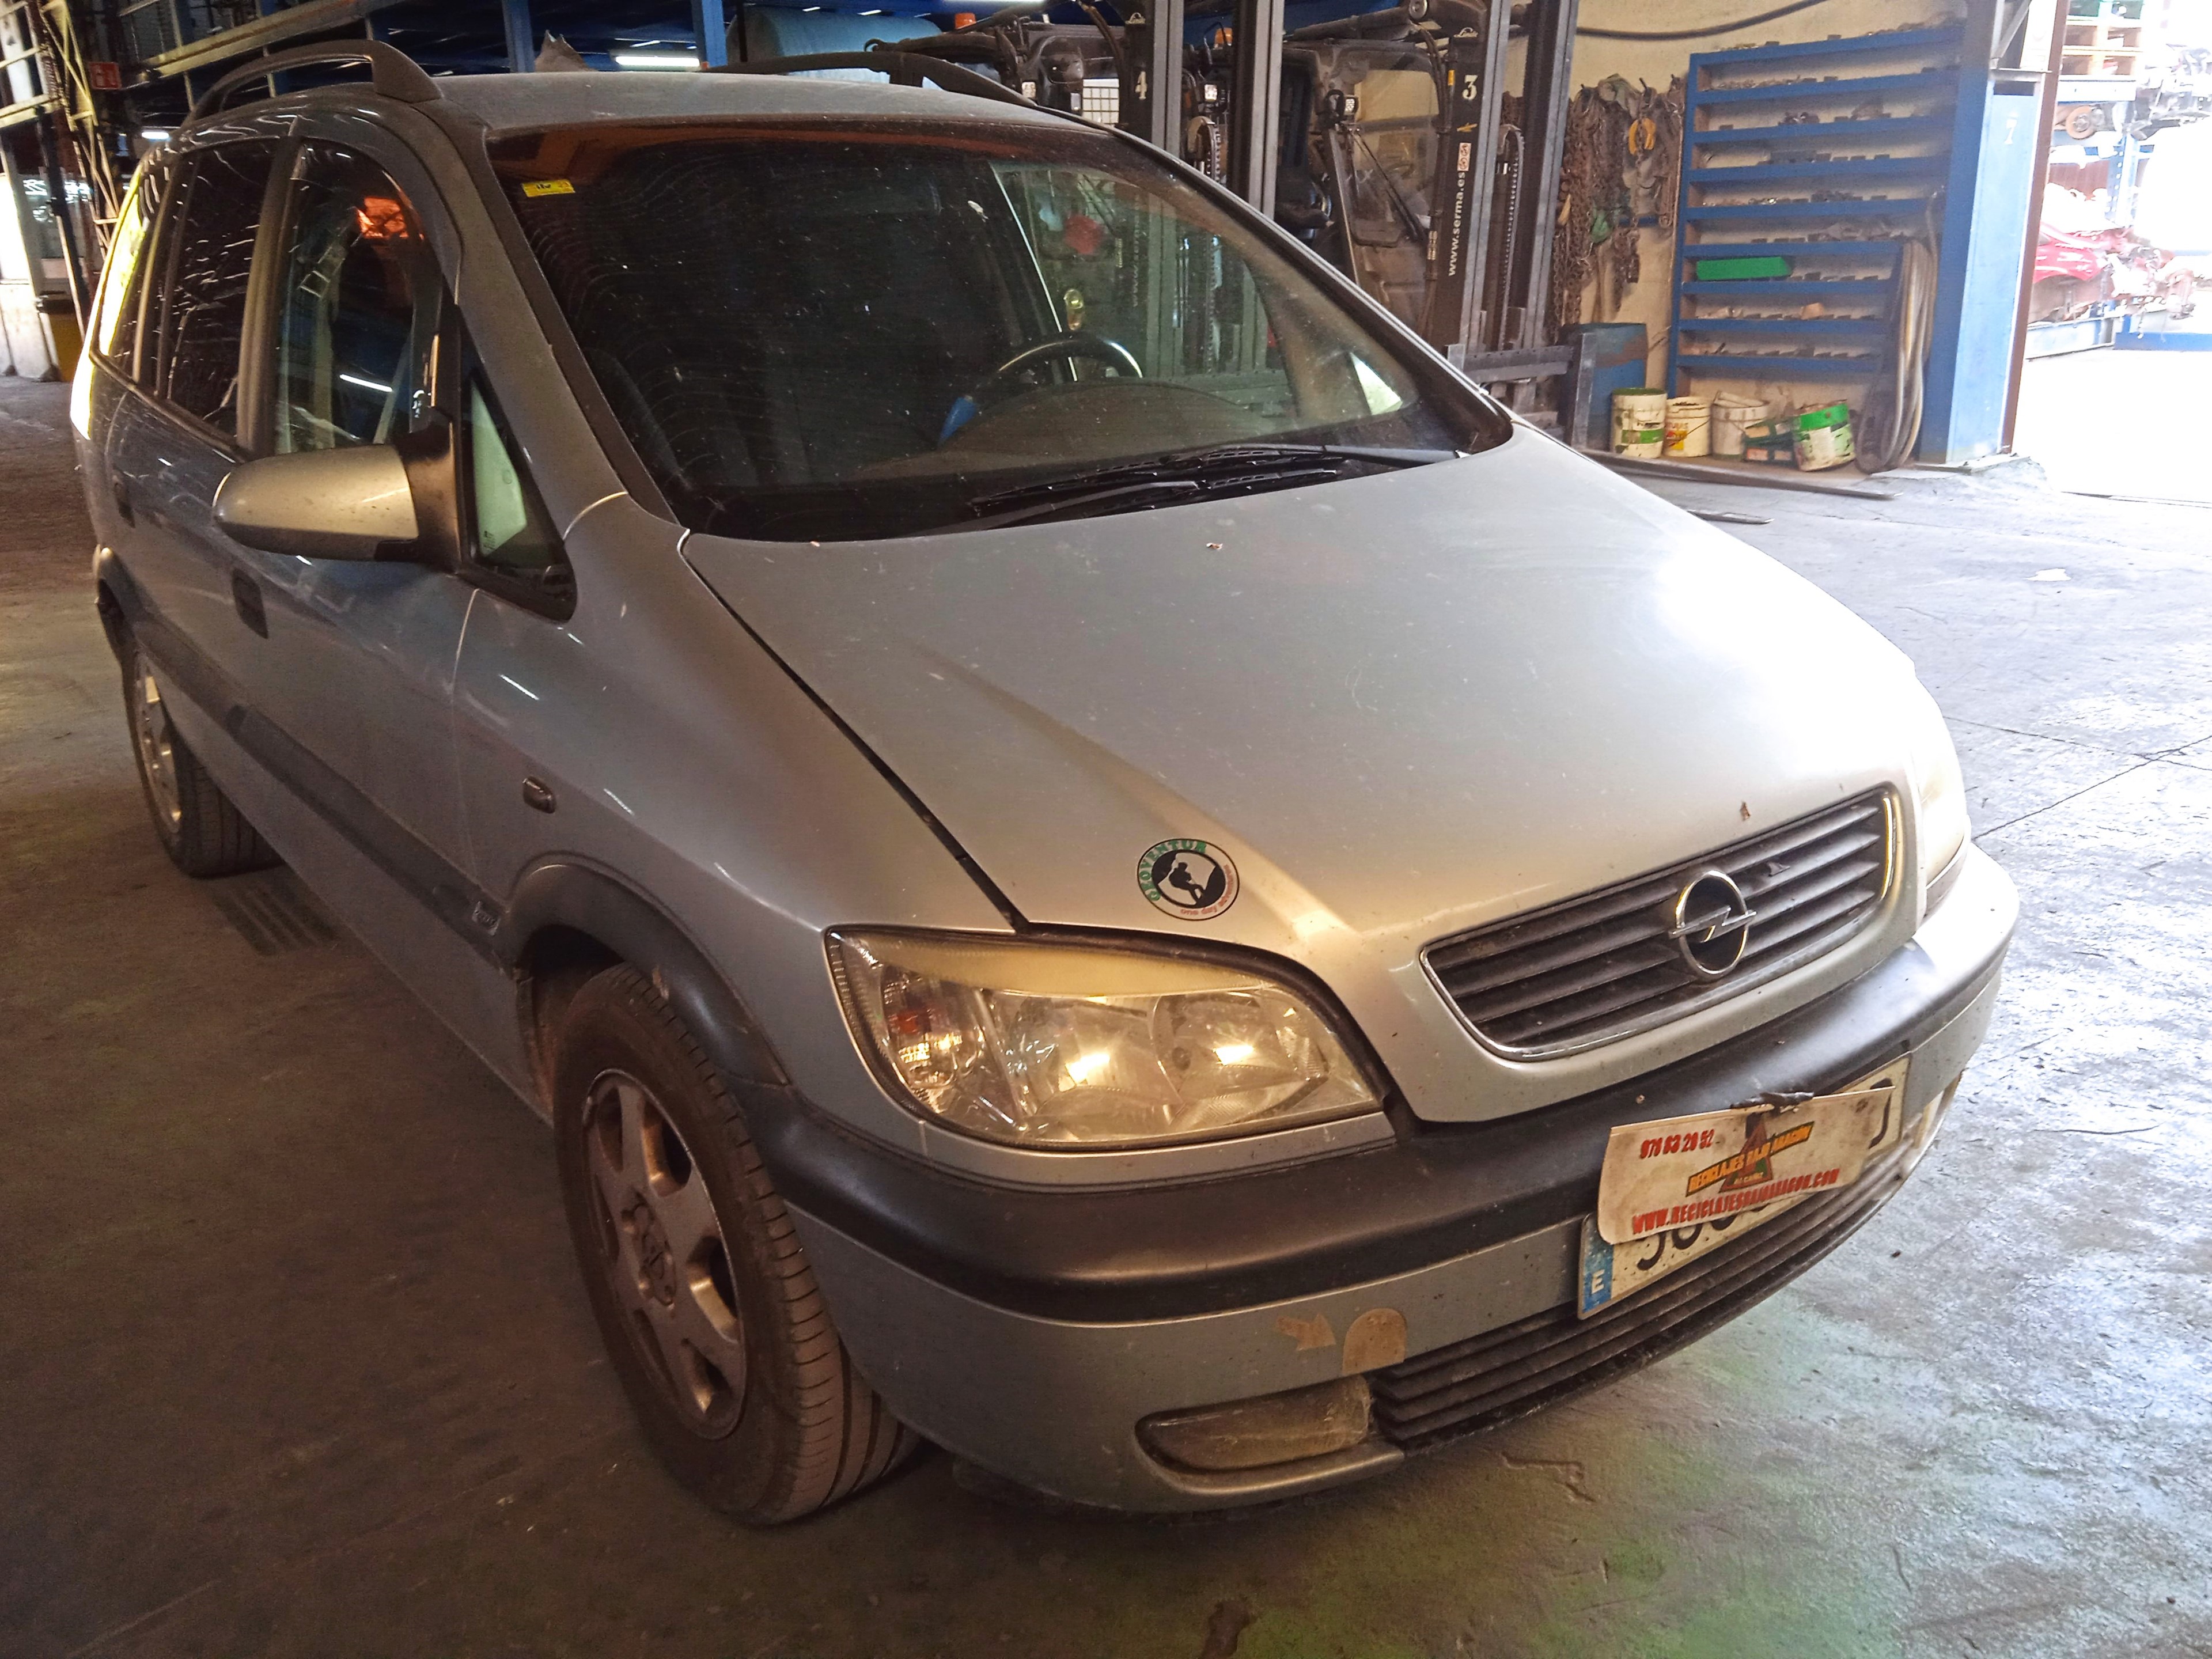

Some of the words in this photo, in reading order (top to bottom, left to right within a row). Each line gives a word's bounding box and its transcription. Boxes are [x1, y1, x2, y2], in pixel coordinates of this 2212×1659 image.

[1135, 71, 1148, 100] 4
[1462, 74, 1478, 100] 3
[1448, 171, 1466, 276] www.serma.es
[1591, 1269, 1605, 1294] E
